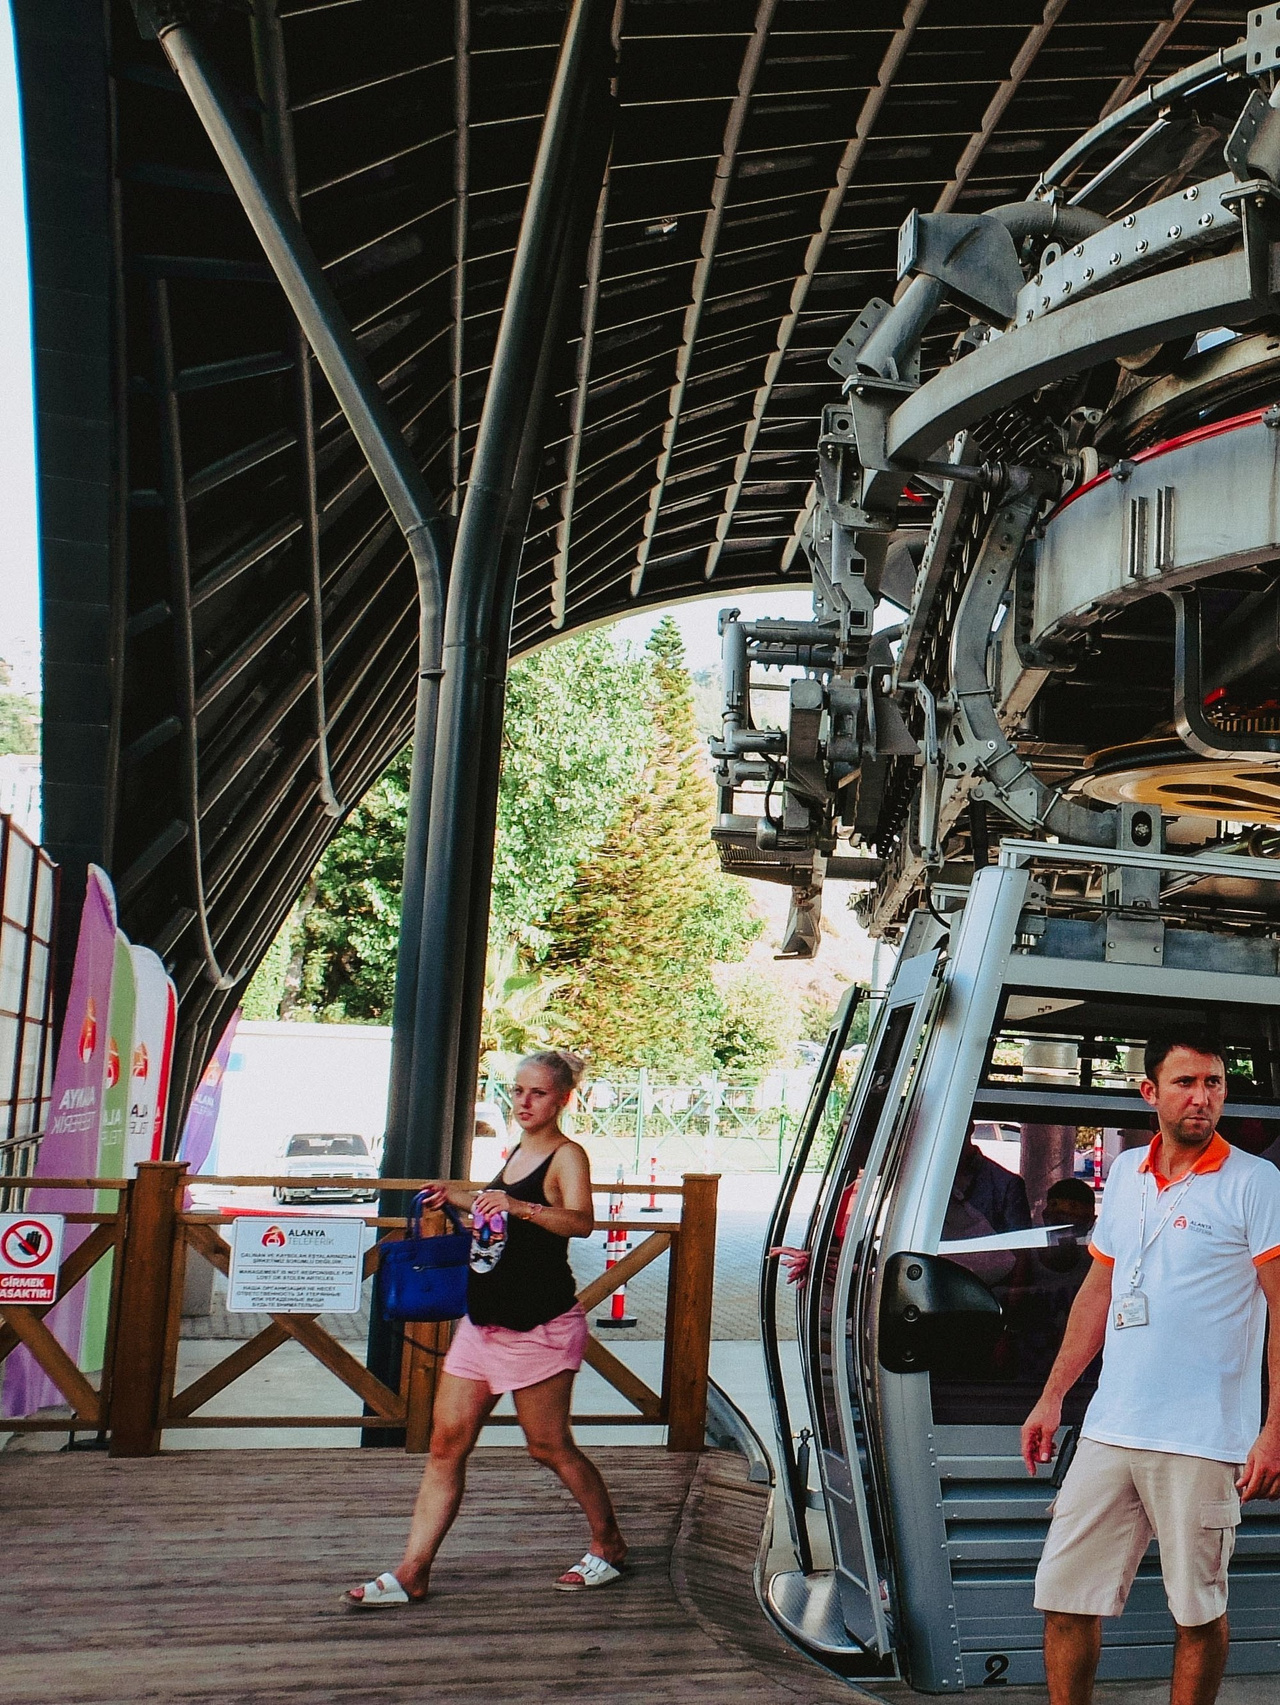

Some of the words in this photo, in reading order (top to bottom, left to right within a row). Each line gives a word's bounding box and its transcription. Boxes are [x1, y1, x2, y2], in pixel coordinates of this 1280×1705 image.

[288, 1229, 326, 1237] ALANYA
[1, 1275, 45, 1288] GİRMEK
[0, 1287, 52, 1299] ASAKTIR!
[983, 1654, 1009, 1686] 2
